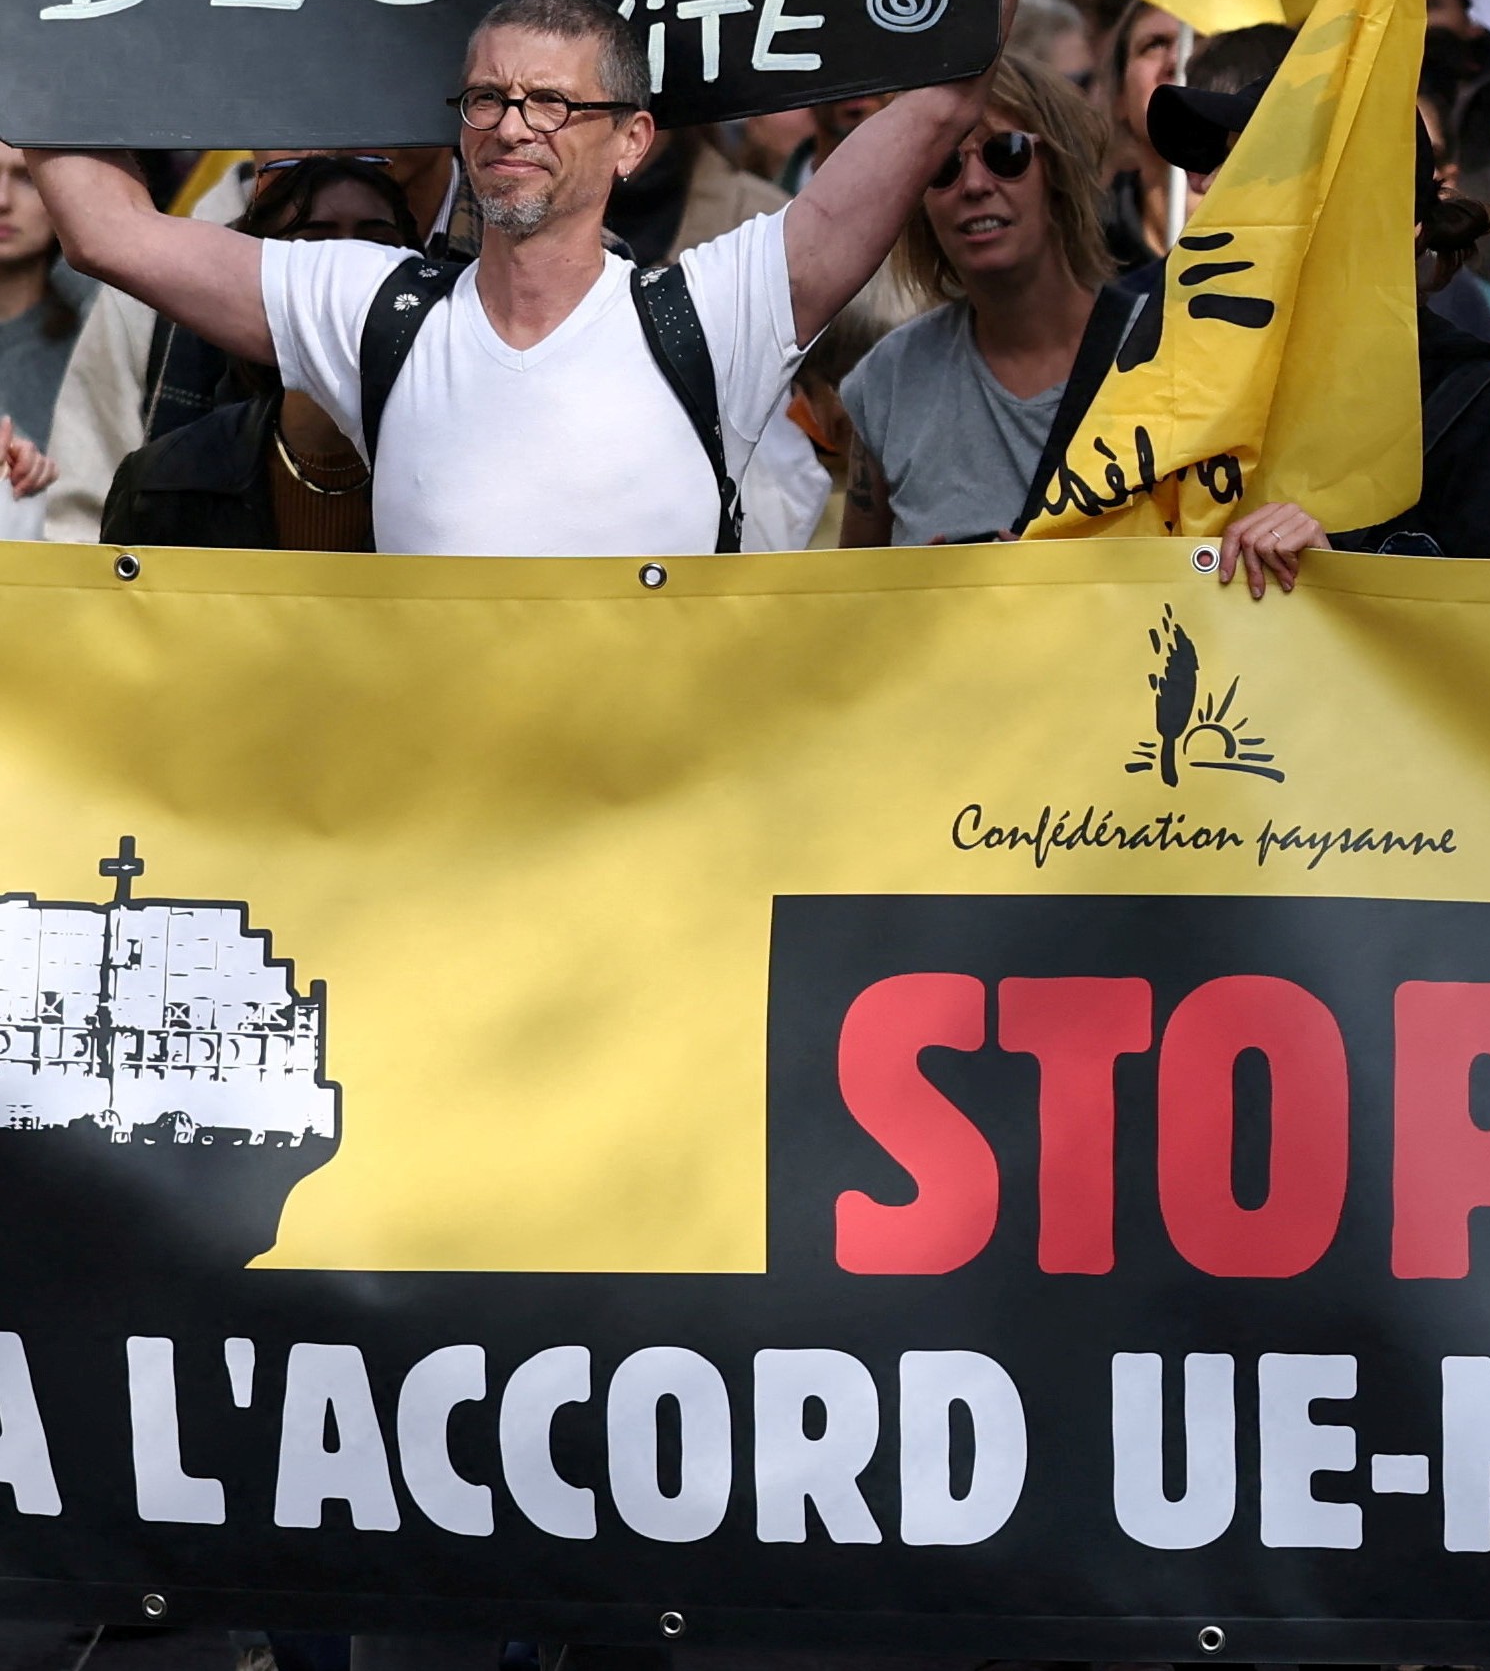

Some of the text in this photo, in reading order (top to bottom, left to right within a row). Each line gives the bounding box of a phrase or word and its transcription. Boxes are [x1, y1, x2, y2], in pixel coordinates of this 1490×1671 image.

[950, 803, 1457, 871] Confédération paysanne
[126, 1335, 1028, 1546] L'ACCORD
